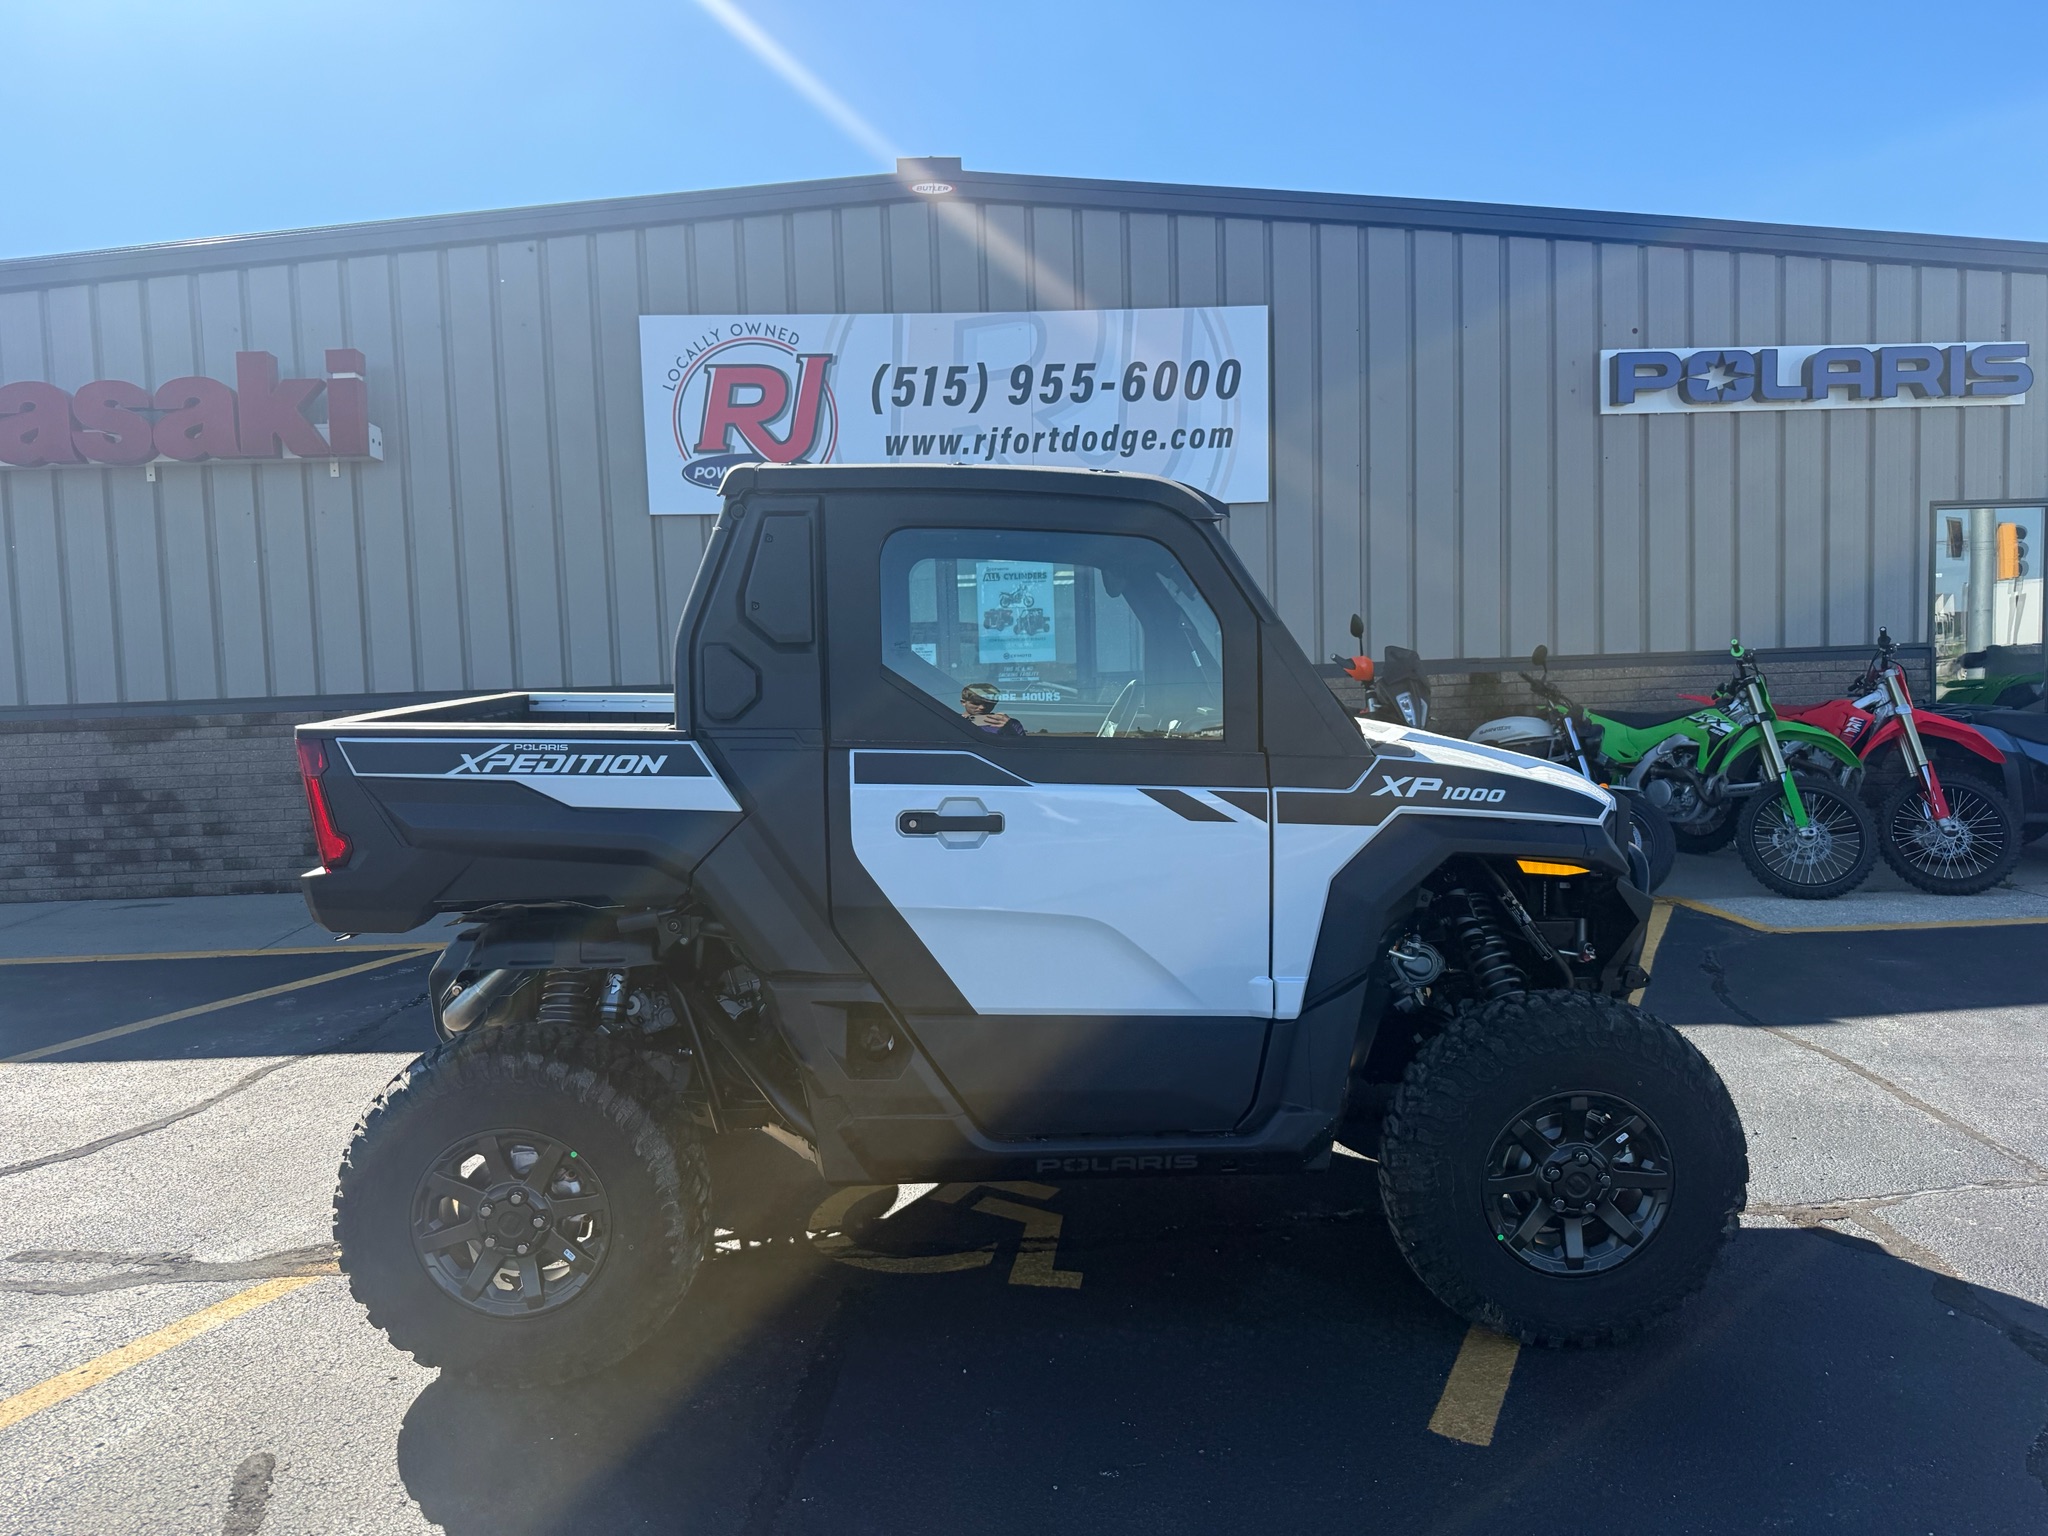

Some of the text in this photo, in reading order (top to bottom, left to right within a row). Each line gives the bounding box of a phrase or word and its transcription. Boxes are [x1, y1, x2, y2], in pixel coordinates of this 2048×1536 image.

[663, 322, 800, 391] LOCALLY OWNED
[871, 359, 1242, 414] (515) 955-6000
[1610, 343, 2035, 406] POLARIS
[695, 353, 835, 463] RJ
[885, 424, 1234, 461] www.rjfortdodge.com
[984, 572, 1047, 581] ALL CYLINDERS
[1022, 692, 1061, 702] HOURS
[445, 744, 668, 775] XPEDITION
[513, 743, 569, 751] POLARIS
[1370, 775, 1506, 803] XP 1000
[1036, 1155, 1199, 1173] POLARIS
